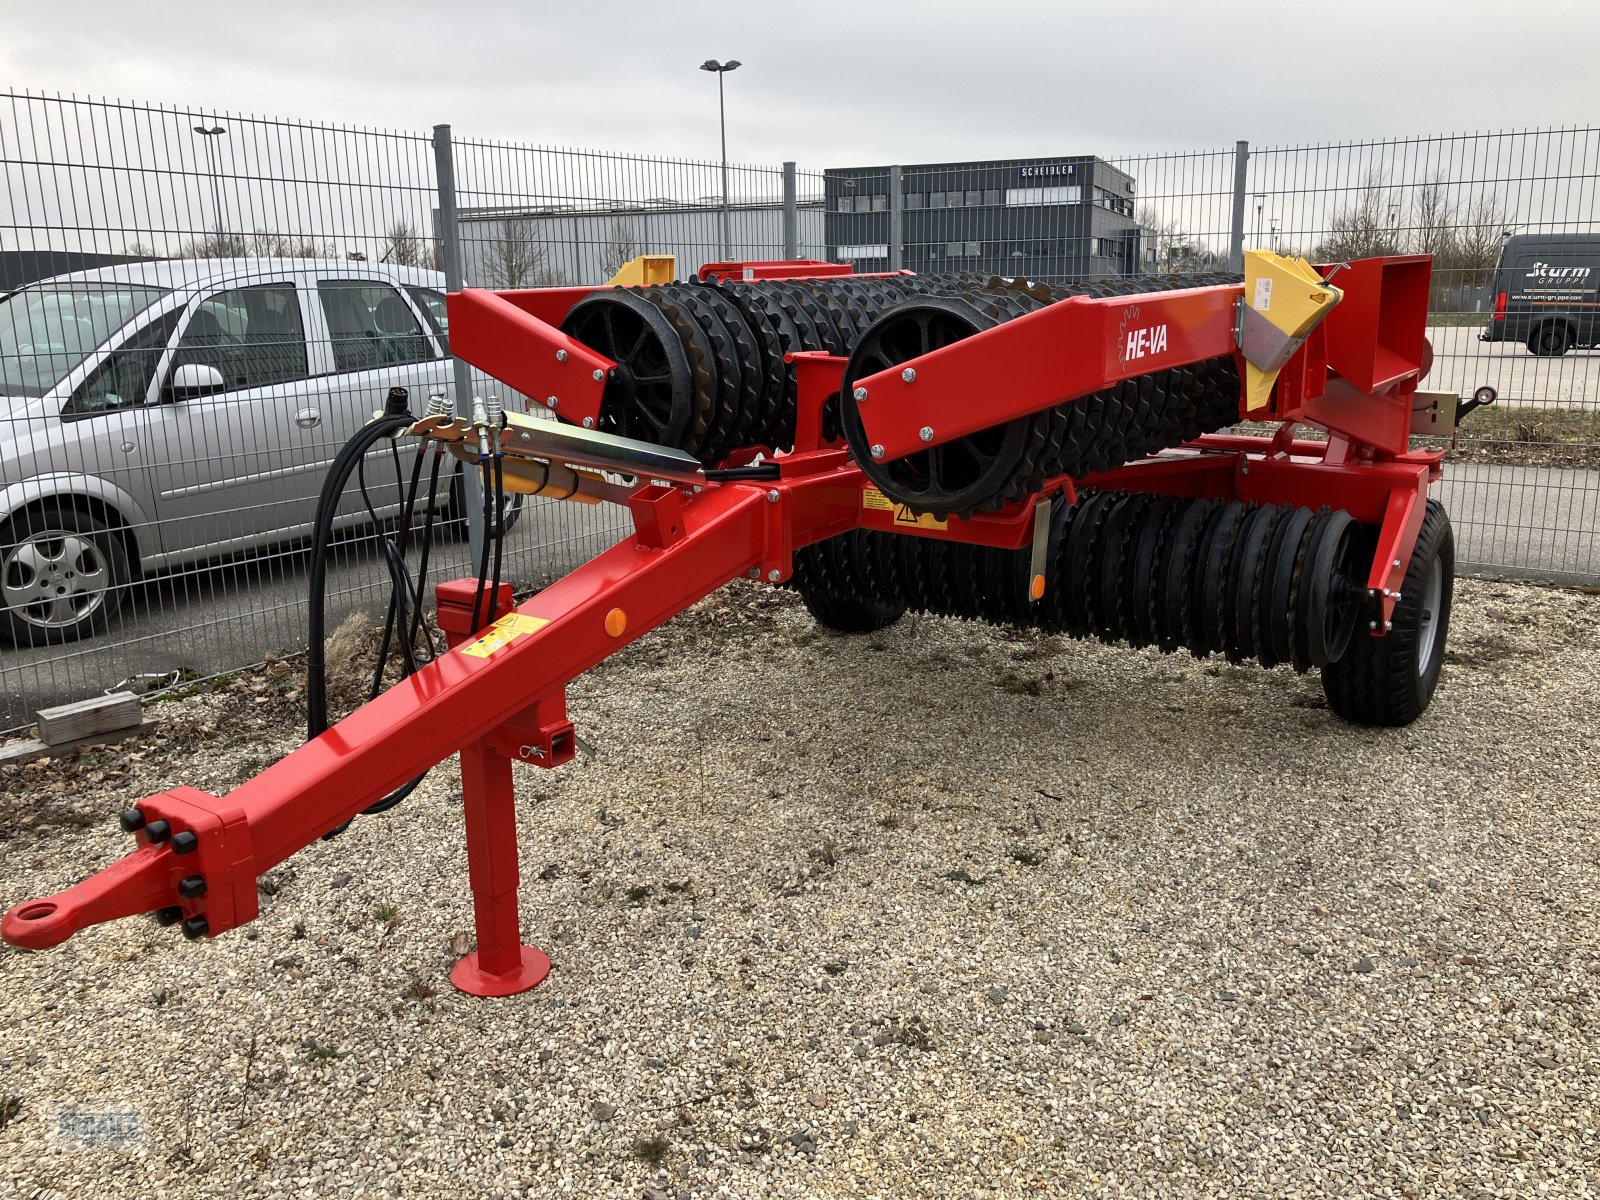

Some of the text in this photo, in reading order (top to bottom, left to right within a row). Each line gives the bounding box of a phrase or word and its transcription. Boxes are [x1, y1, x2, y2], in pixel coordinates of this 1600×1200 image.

[1021, 165, 1073, 177] SCHEIBLER
[1526, 262, 1590, 277] Sturm
[1125, 324, 1168, 362] HE-VA
